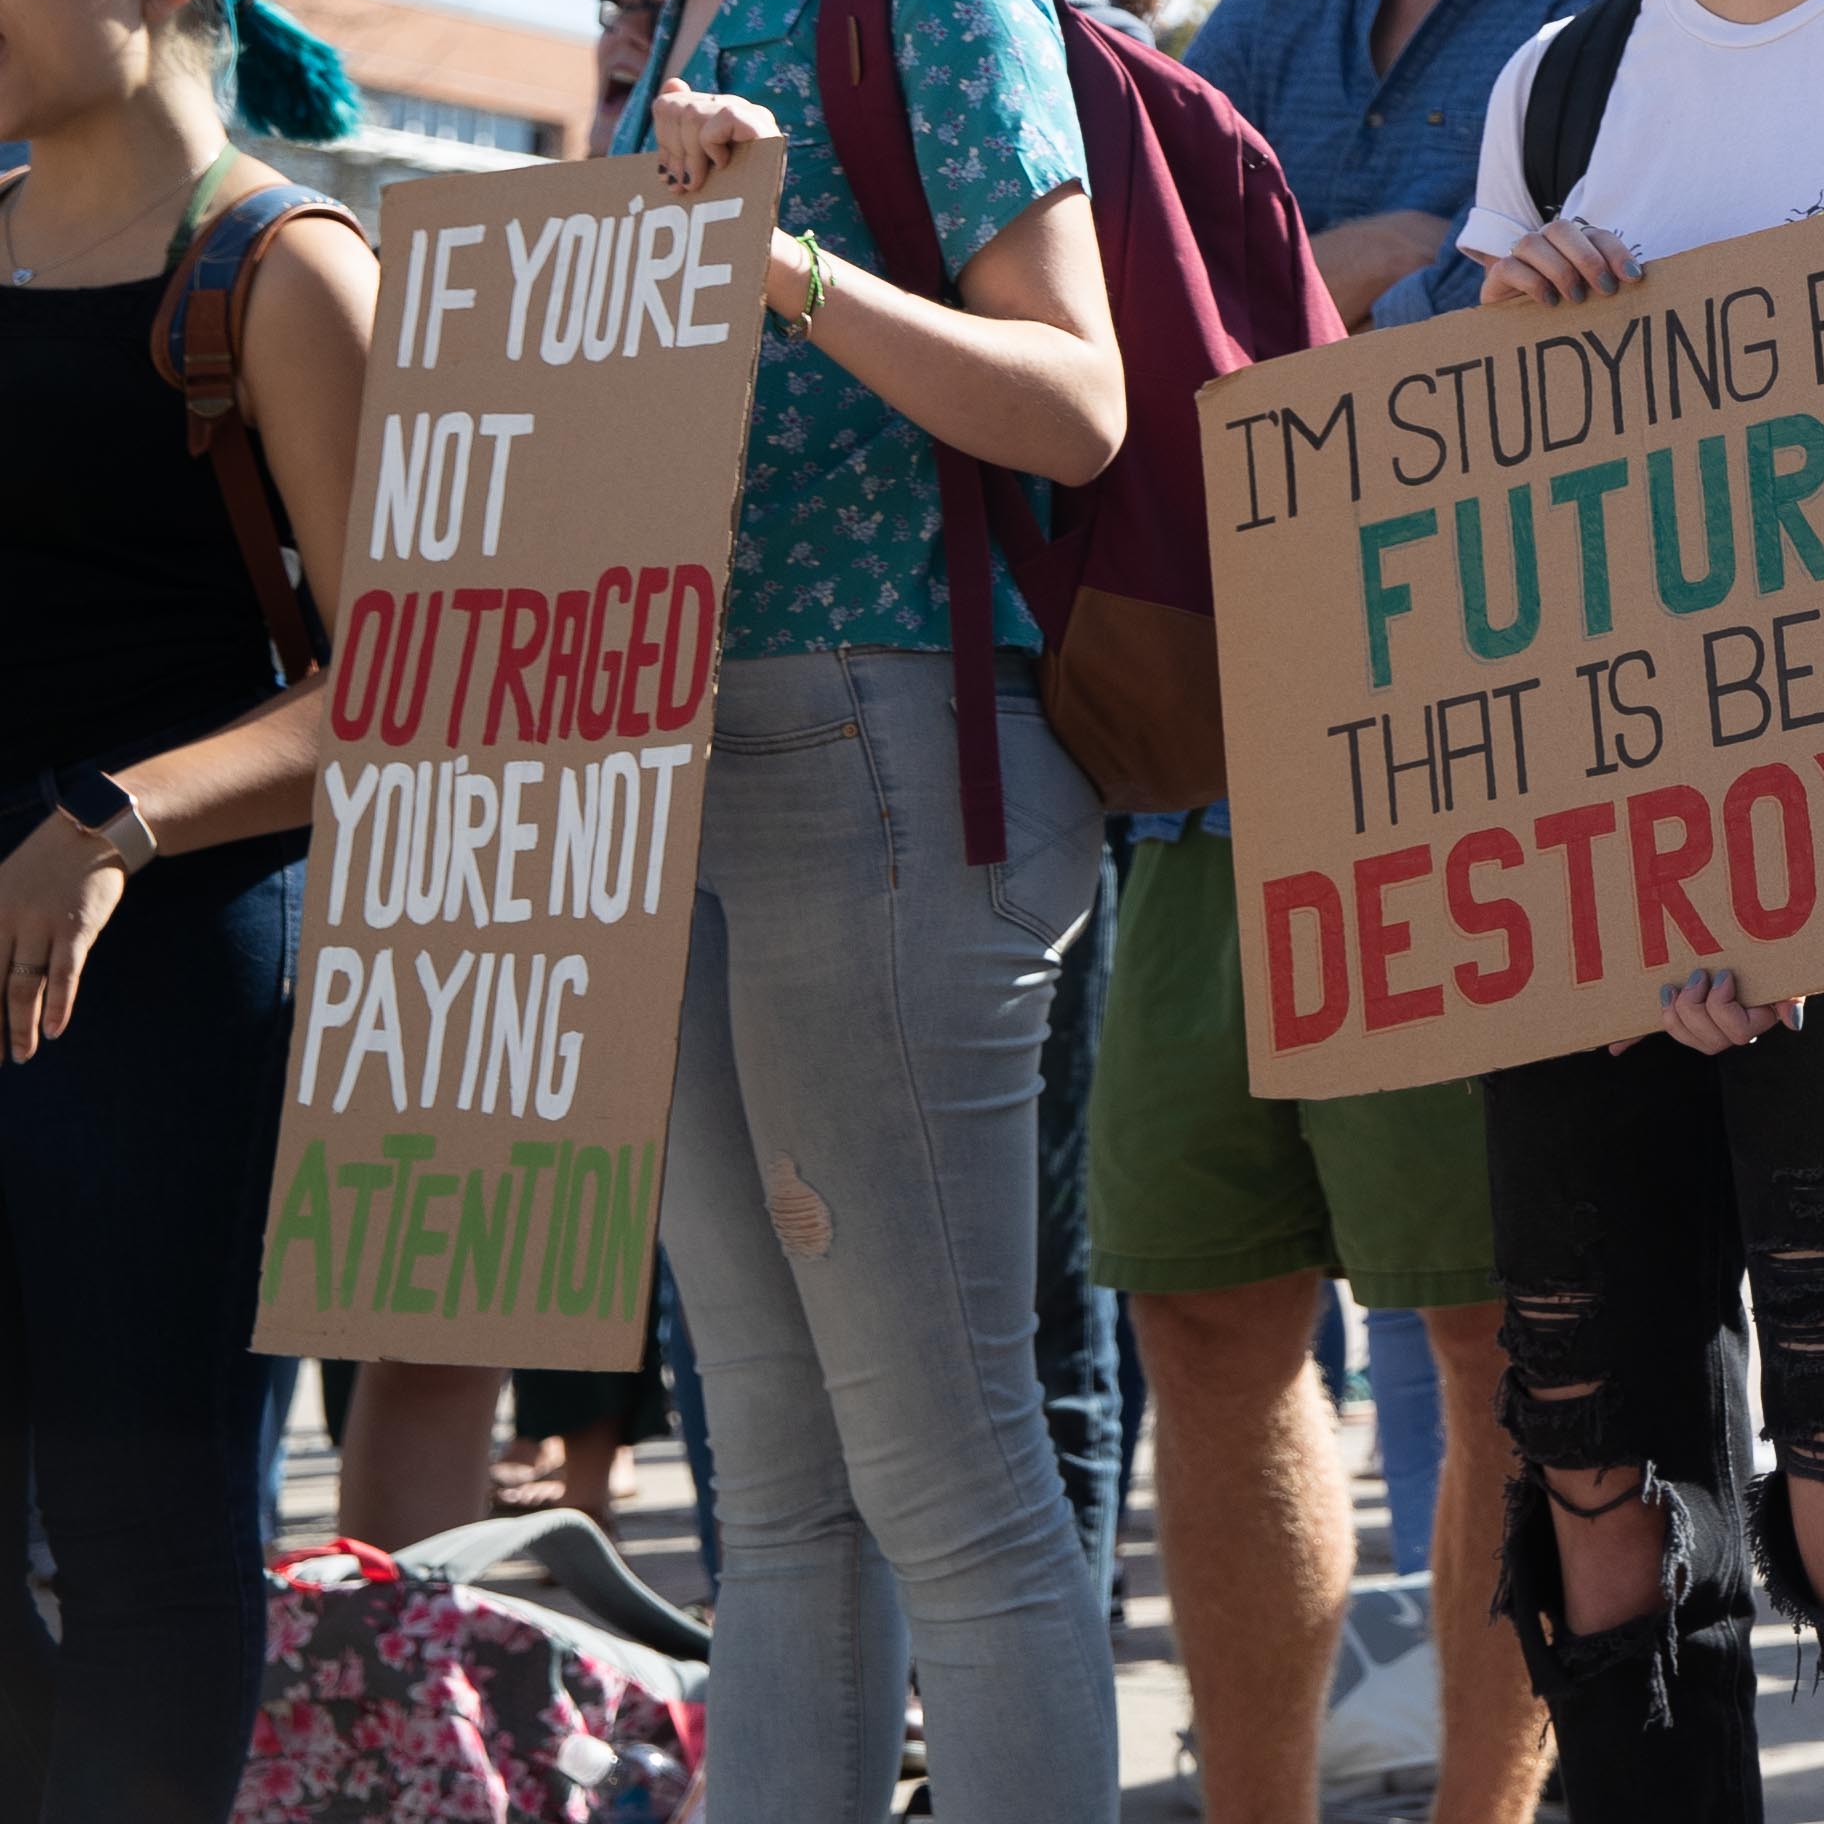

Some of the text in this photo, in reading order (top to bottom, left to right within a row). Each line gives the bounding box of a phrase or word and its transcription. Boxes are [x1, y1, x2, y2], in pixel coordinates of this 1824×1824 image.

[396, 222, 487, 369] IF
[371, 412, 535, 562] NOT
[1225, 391, 1361, 532] I'M
[1387, 285, 1779, 487] STUDYING
[330, 563, 716, 747] OUTRAGED
[1327, 678, 1540, 835] THAT
[1575, 649, 1664, 778] IS
[548, 744, 693, 923] NOT
[297, 946, 590, 1121] PAYING
[263, 1133, 656, 1321] ATTENTION
